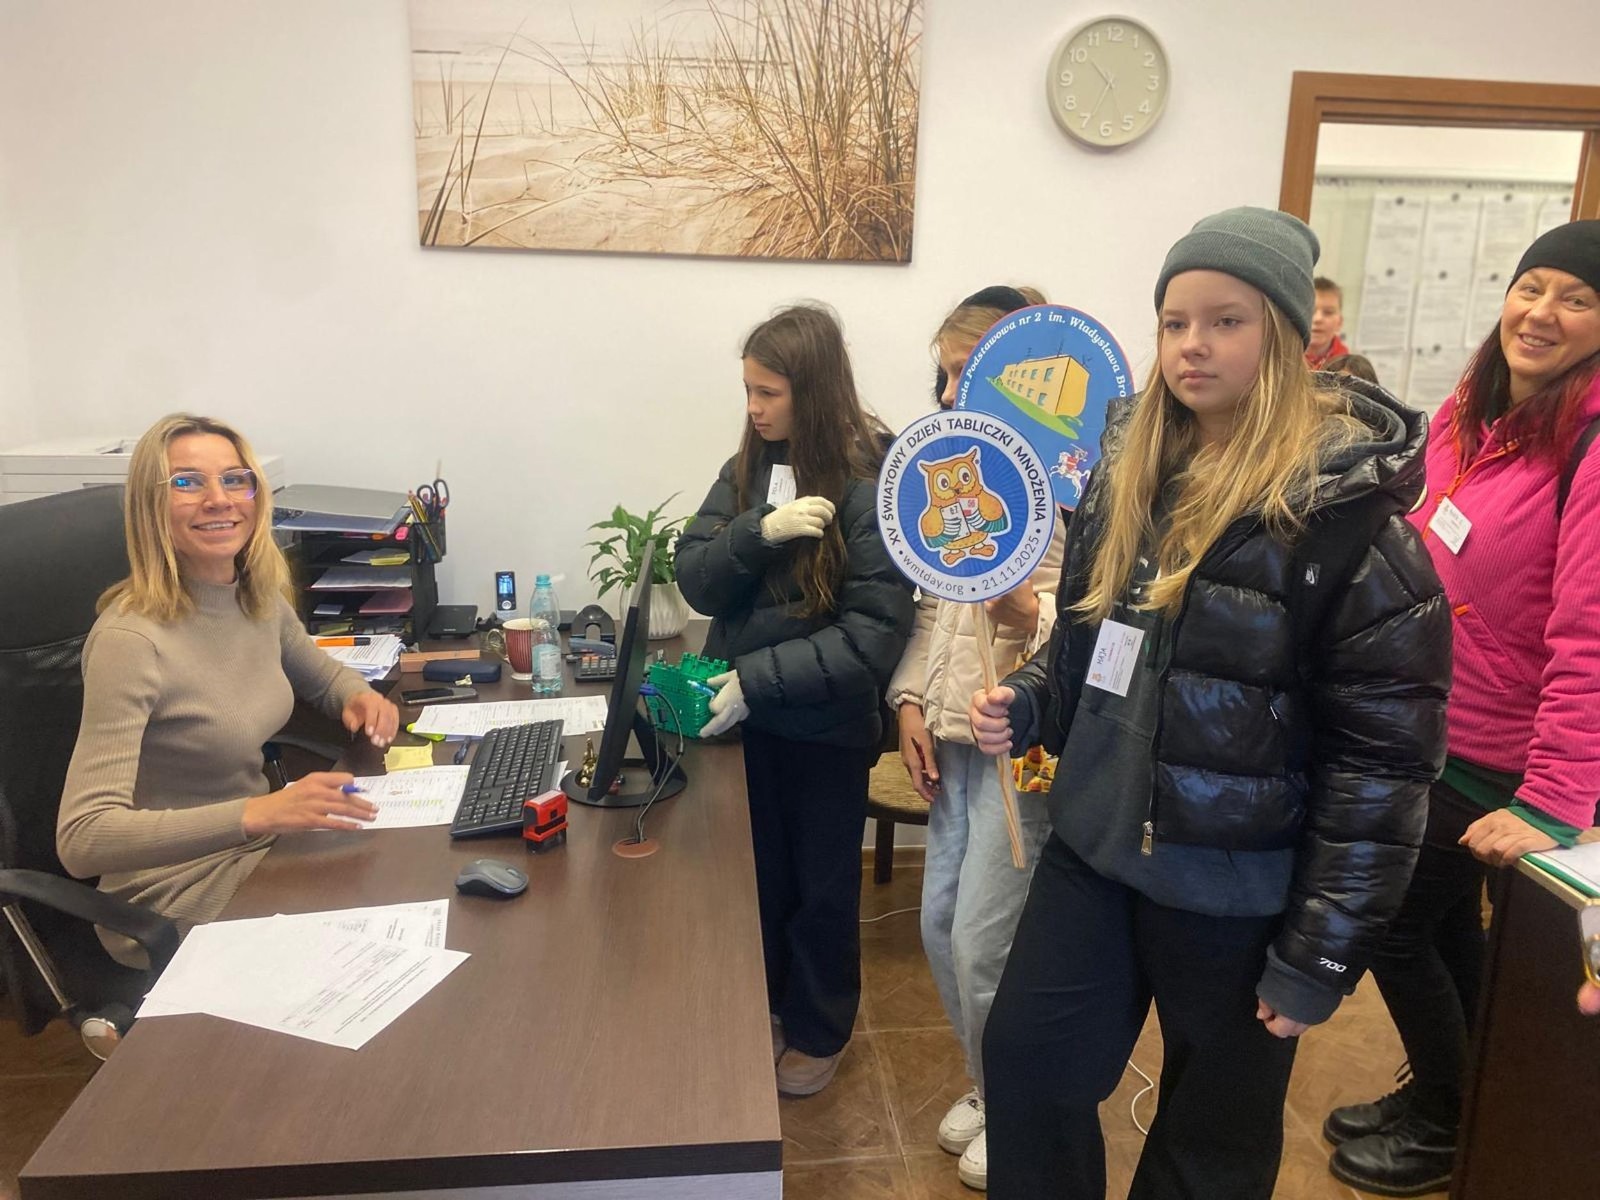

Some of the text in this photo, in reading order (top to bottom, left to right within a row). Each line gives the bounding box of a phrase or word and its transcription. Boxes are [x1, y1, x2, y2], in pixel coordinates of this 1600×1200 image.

[1088, 31, 1100, 47] 11
[1107, 26, 1124, 43] 12
[1132, 34, 1139, 49] 1
[1069, 48, 1088, 63] 10
[1143, 52, 1156, 68] 2
[1060, 71, 1073, 87] 9
[1147, 75, 1159, 91] 3
[1064, 95, 1077, 111] 8
[1138, 100, 1151, 115] 4
[1079, 112, 1091, 129] 7
[1121, 115, 1134, 132] 5
[1099, 121, 1113, 137] 6
[959, 312, 1127, 408] koła Podstawowa nr 2 im. Władysława Bro
[882, 418, 1046, 546] XV ŚWIATOWY DZIEŃ TABLICZKI MNOŻENIA
[903, 535, 1040, 595] wmtday.org 21.11.2025
